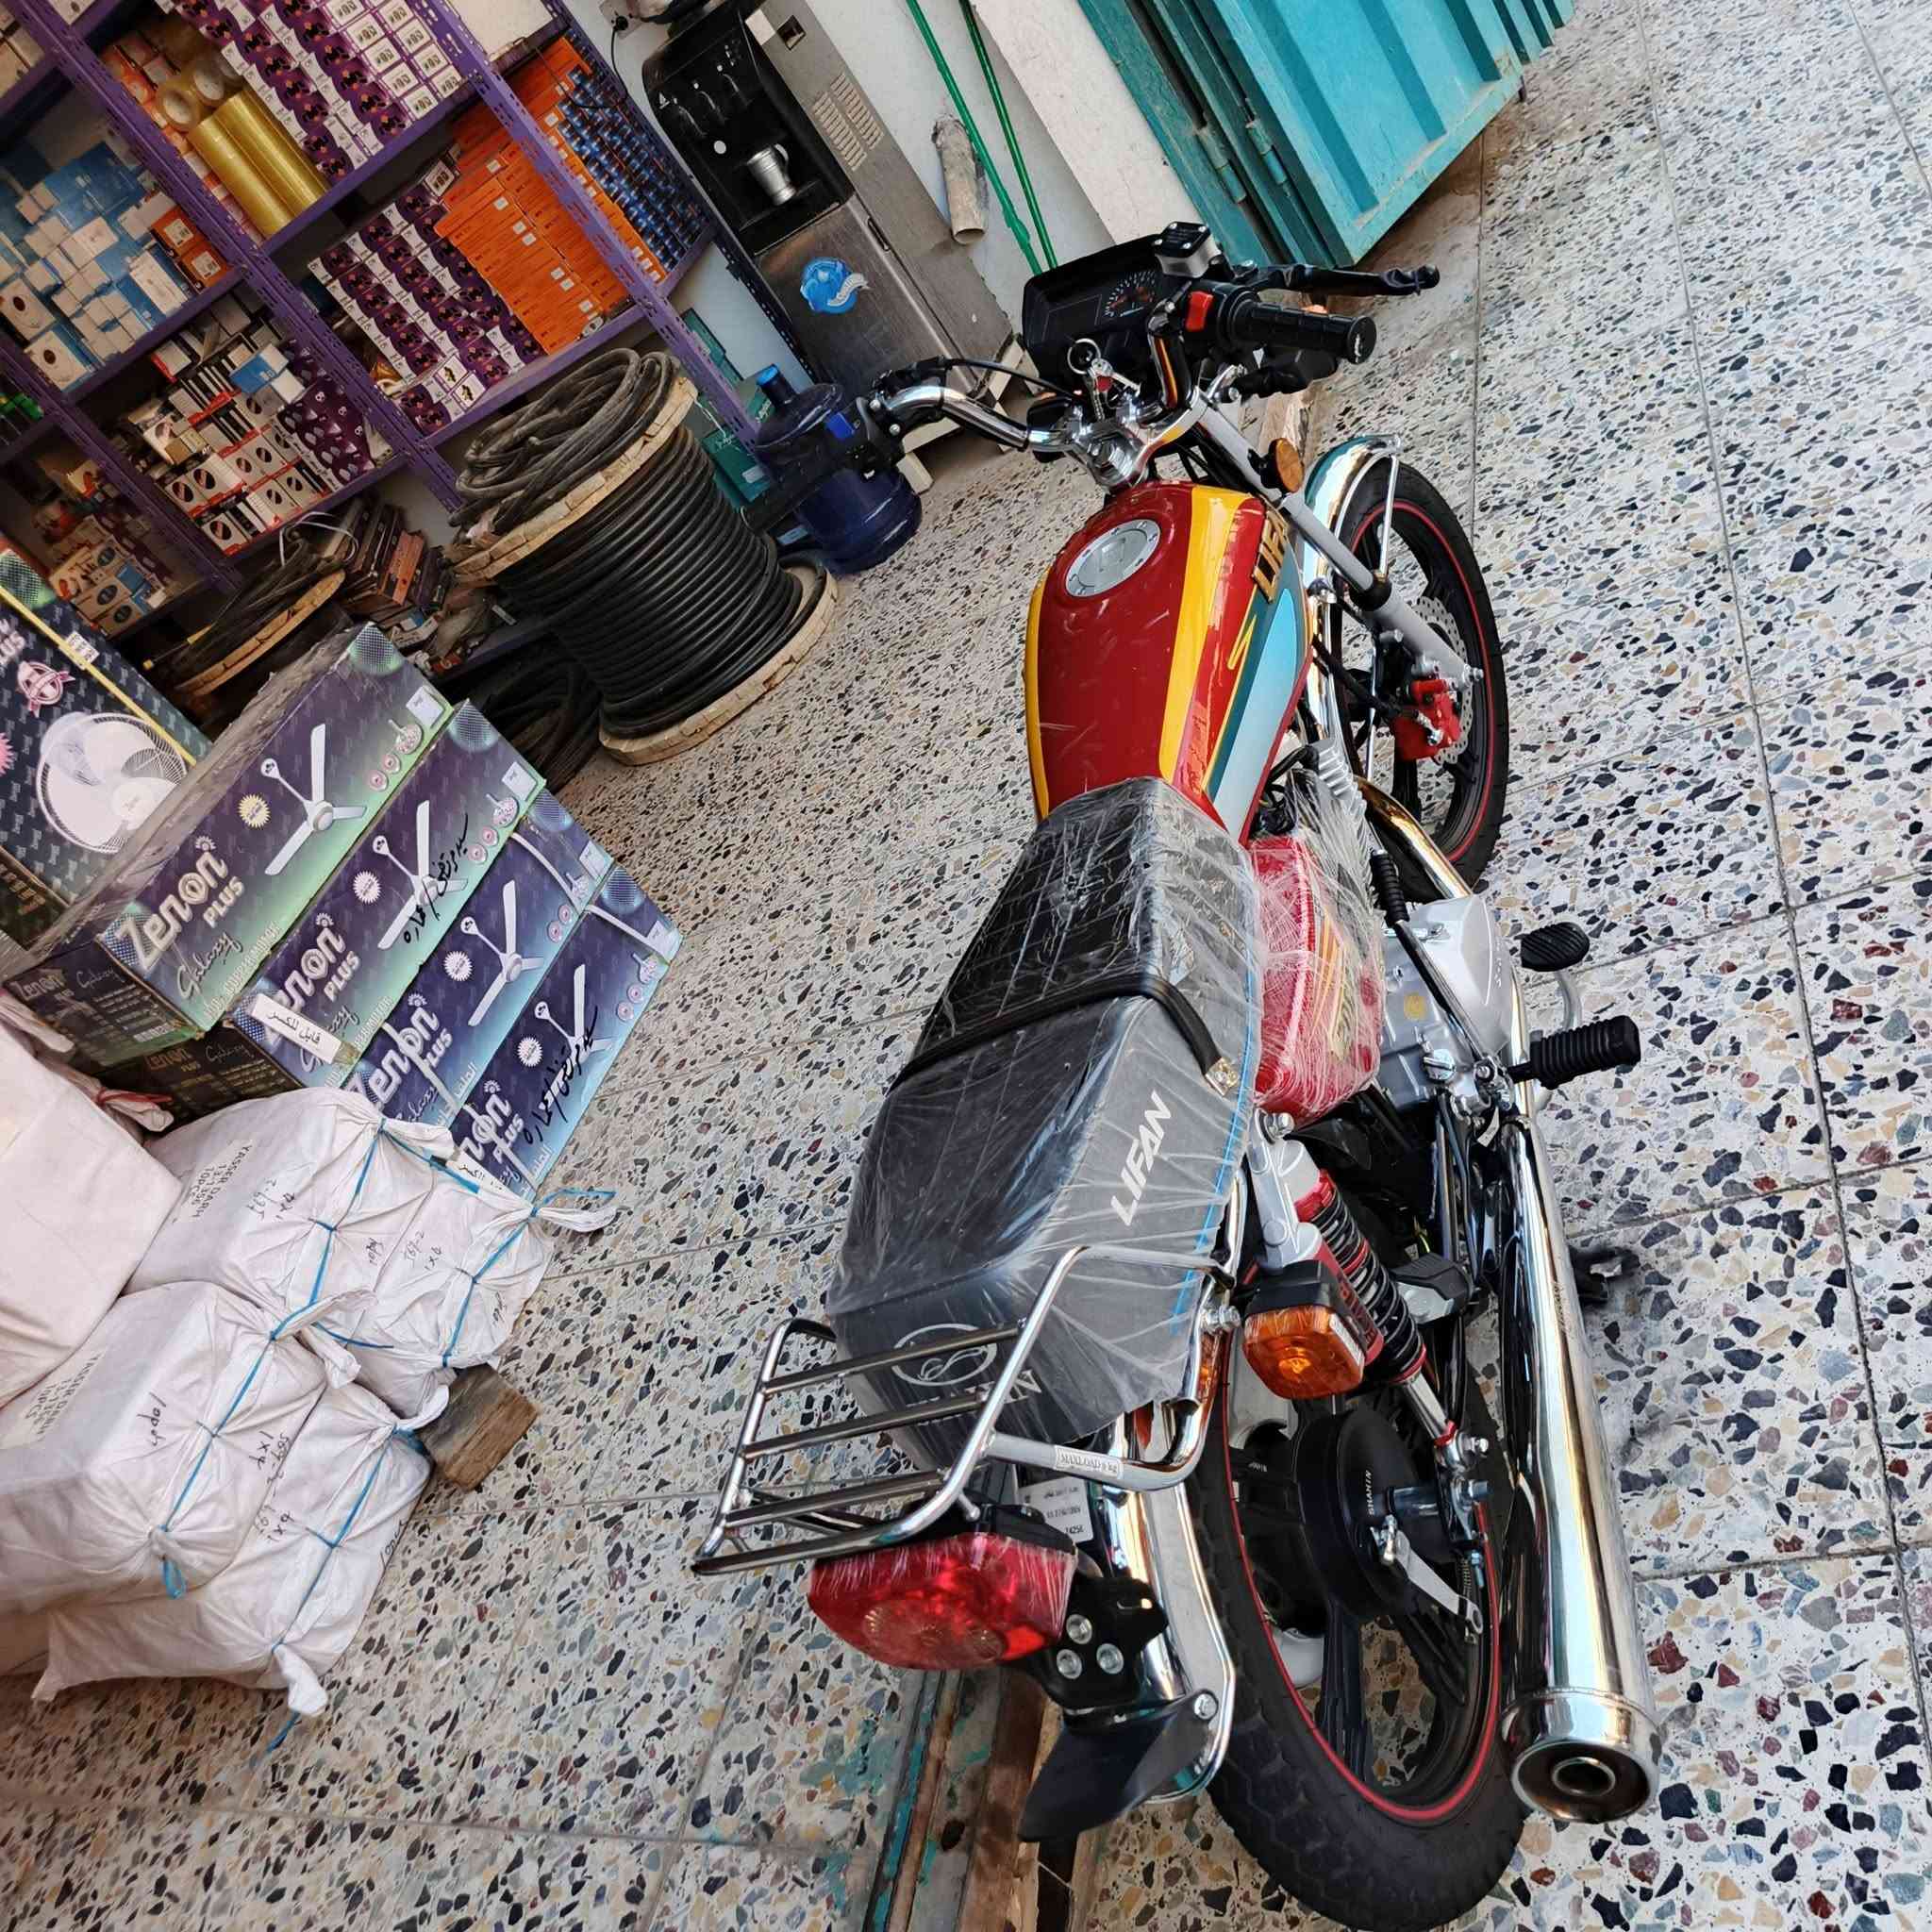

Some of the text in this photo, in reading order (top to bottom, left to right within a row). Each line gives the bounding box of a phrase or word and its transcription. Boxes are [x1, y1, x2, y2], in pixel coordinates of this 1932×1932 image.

[203, 876, 245, 928] PLUS
[175, 931, 243, 1000] Galaxy
[324, 950, 361, 1002] PLUS
[267, 1007, 323, 1046] قابل للكسر
[425, 1028, 453, 1069] LUS
[1110, 1090, 1172, 1226] LIFAN
